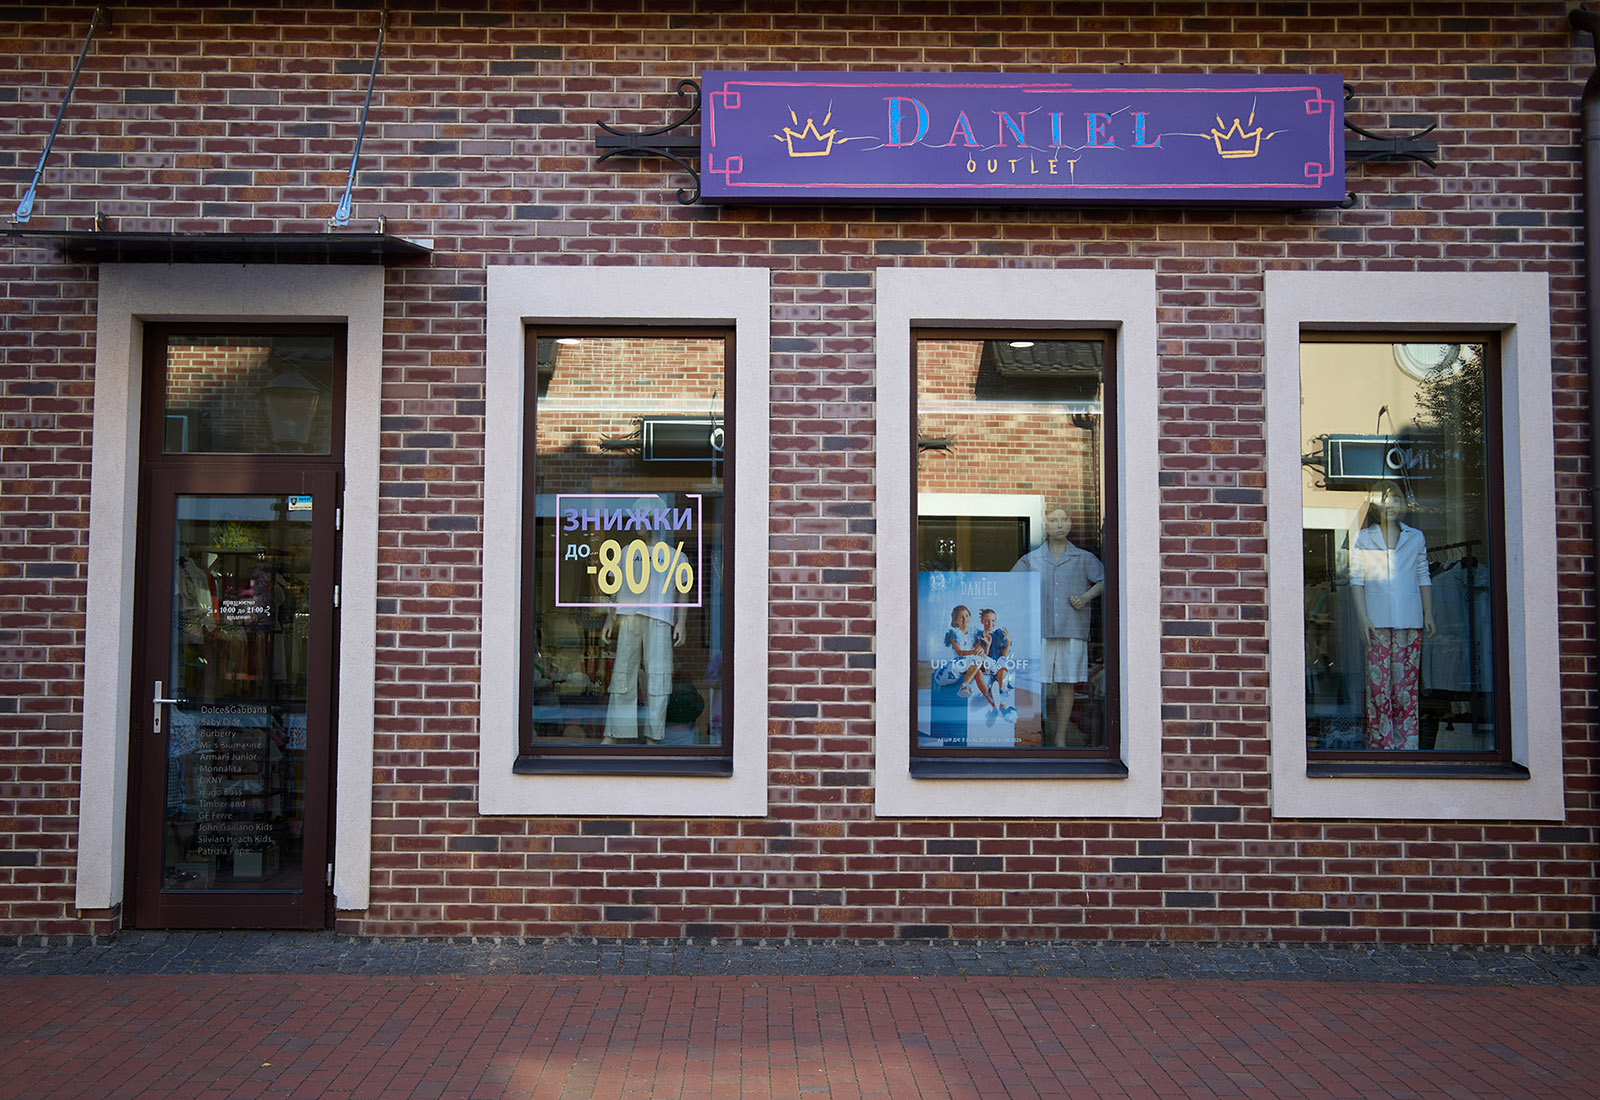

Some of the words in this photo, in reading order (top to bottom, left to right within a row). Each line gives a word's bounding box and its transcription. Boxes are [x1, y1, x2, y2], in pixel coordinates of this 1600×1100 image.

[883, 96, 1163, 148] DANIEL
[966, 157, 1079, 176] OUTLET
[563, 508, 693, 531] ЗНИЖКИ
[587, 539, 694, 595] -80%
[961, 579, 999, 596] DANIEL
[220, 606, 236, 614] 10:00
[246, 606, 264, 614] 21:00
[931, 659, 948, 670] UP
[952, 659, 968, 670] TO
[1006, 659, 1029, 670] OFF
[201, 705, 268, 714] Dolce&Gabbana
[201, 717, 221, 728] Baby
[222, 717, 241, 726] Dior
[200, 729, 237, 738] Burberry
[200, 741, 218, 749] Mis
[200, 753, 230, 761] Armani
[232, 752, 258, 761] Junior
[200, 764, 242, 773] Monnalisa
[200, 776, 223, 784] DKNY
[200, 788, 222, 798] Hugo
[199, 799, 246, 808] Timberand
[211, 811, 233, 820] Ferre
[198, 823, 219, 832] John
[255, 822, 273, 831] Kids
[198, 834, 225, 843] Silvian
[254, 834, 272, 843] Kids
[197, 846, 228, 855] Patrizia
[229, 847, 250, 857] Pepe
